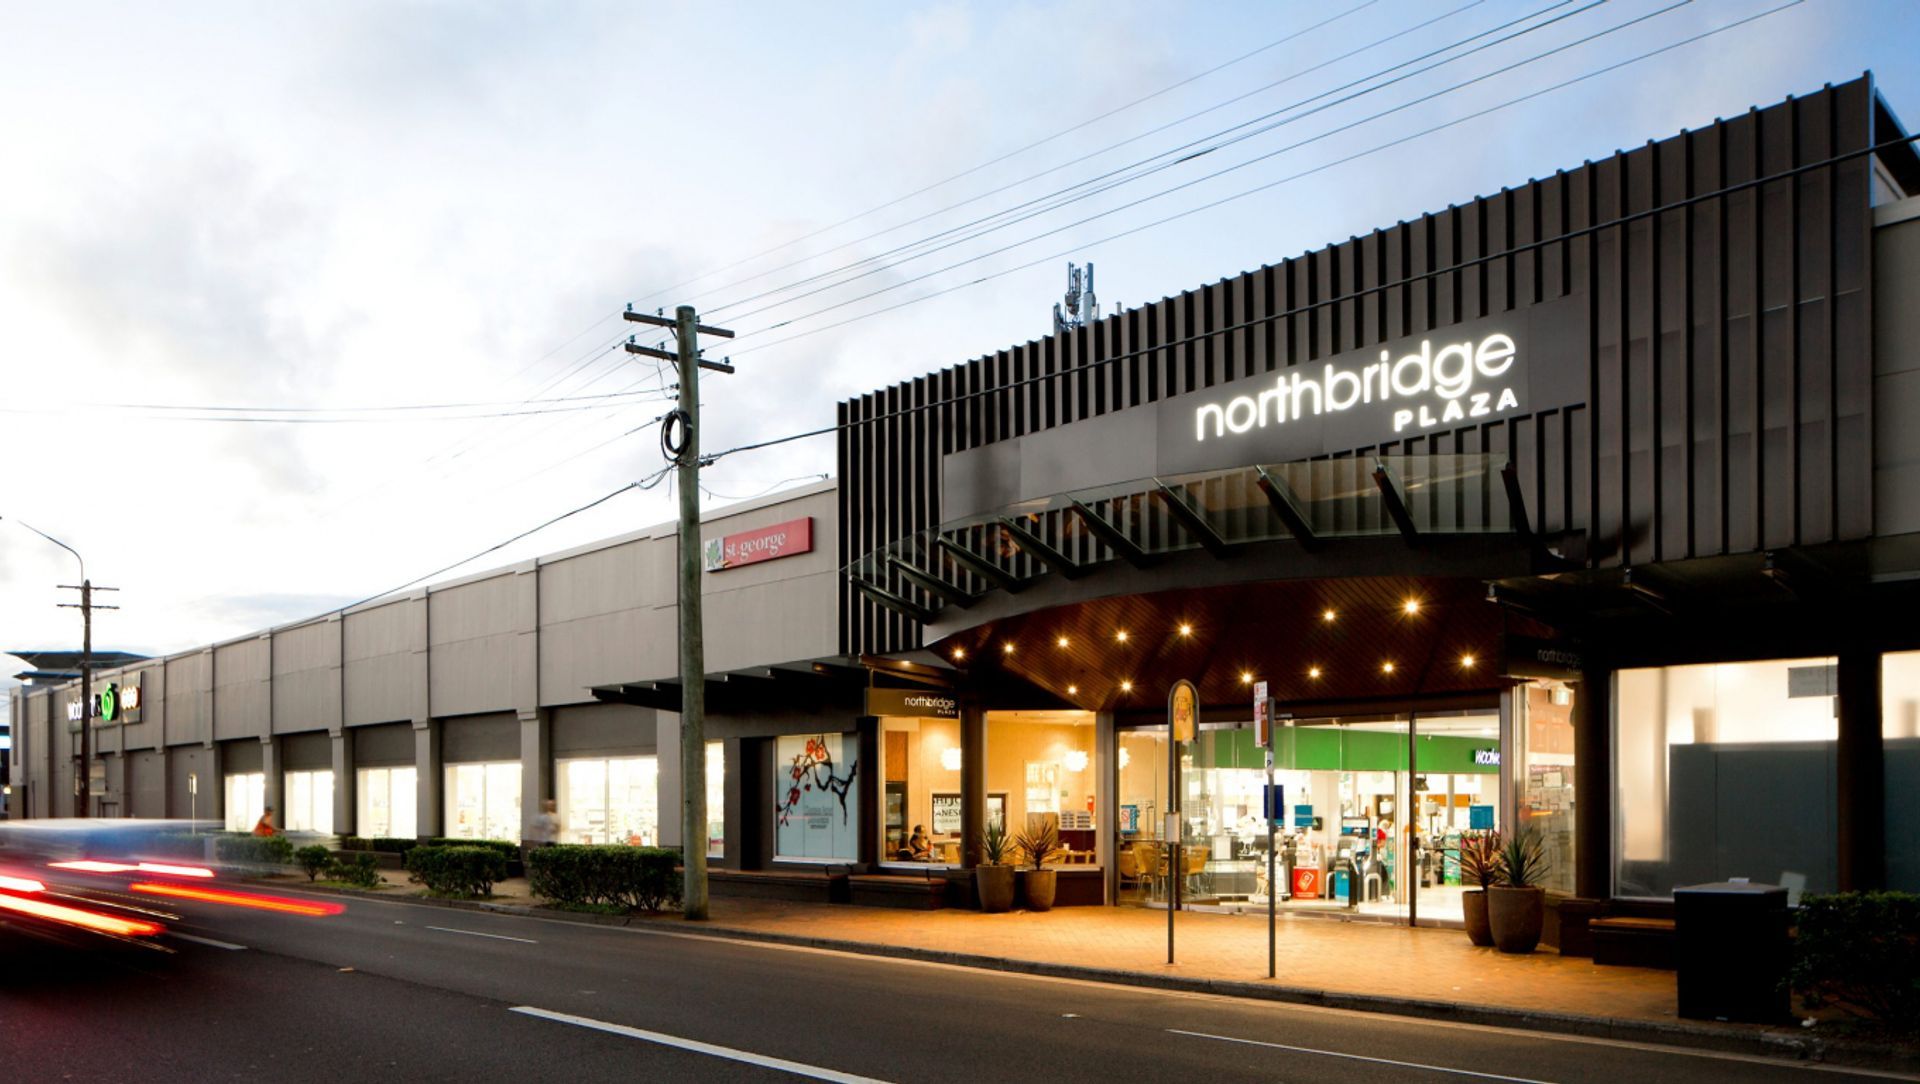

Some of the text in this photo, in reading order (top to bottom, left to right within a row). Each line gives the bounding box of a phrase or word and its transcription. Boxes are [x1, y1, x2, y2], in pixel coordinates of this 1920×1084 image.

[1197, 334, 1517, 441] northbridge
[1393, 388, 1519, 432] PLAZA
[904, 696, 956, 710] northbridge
